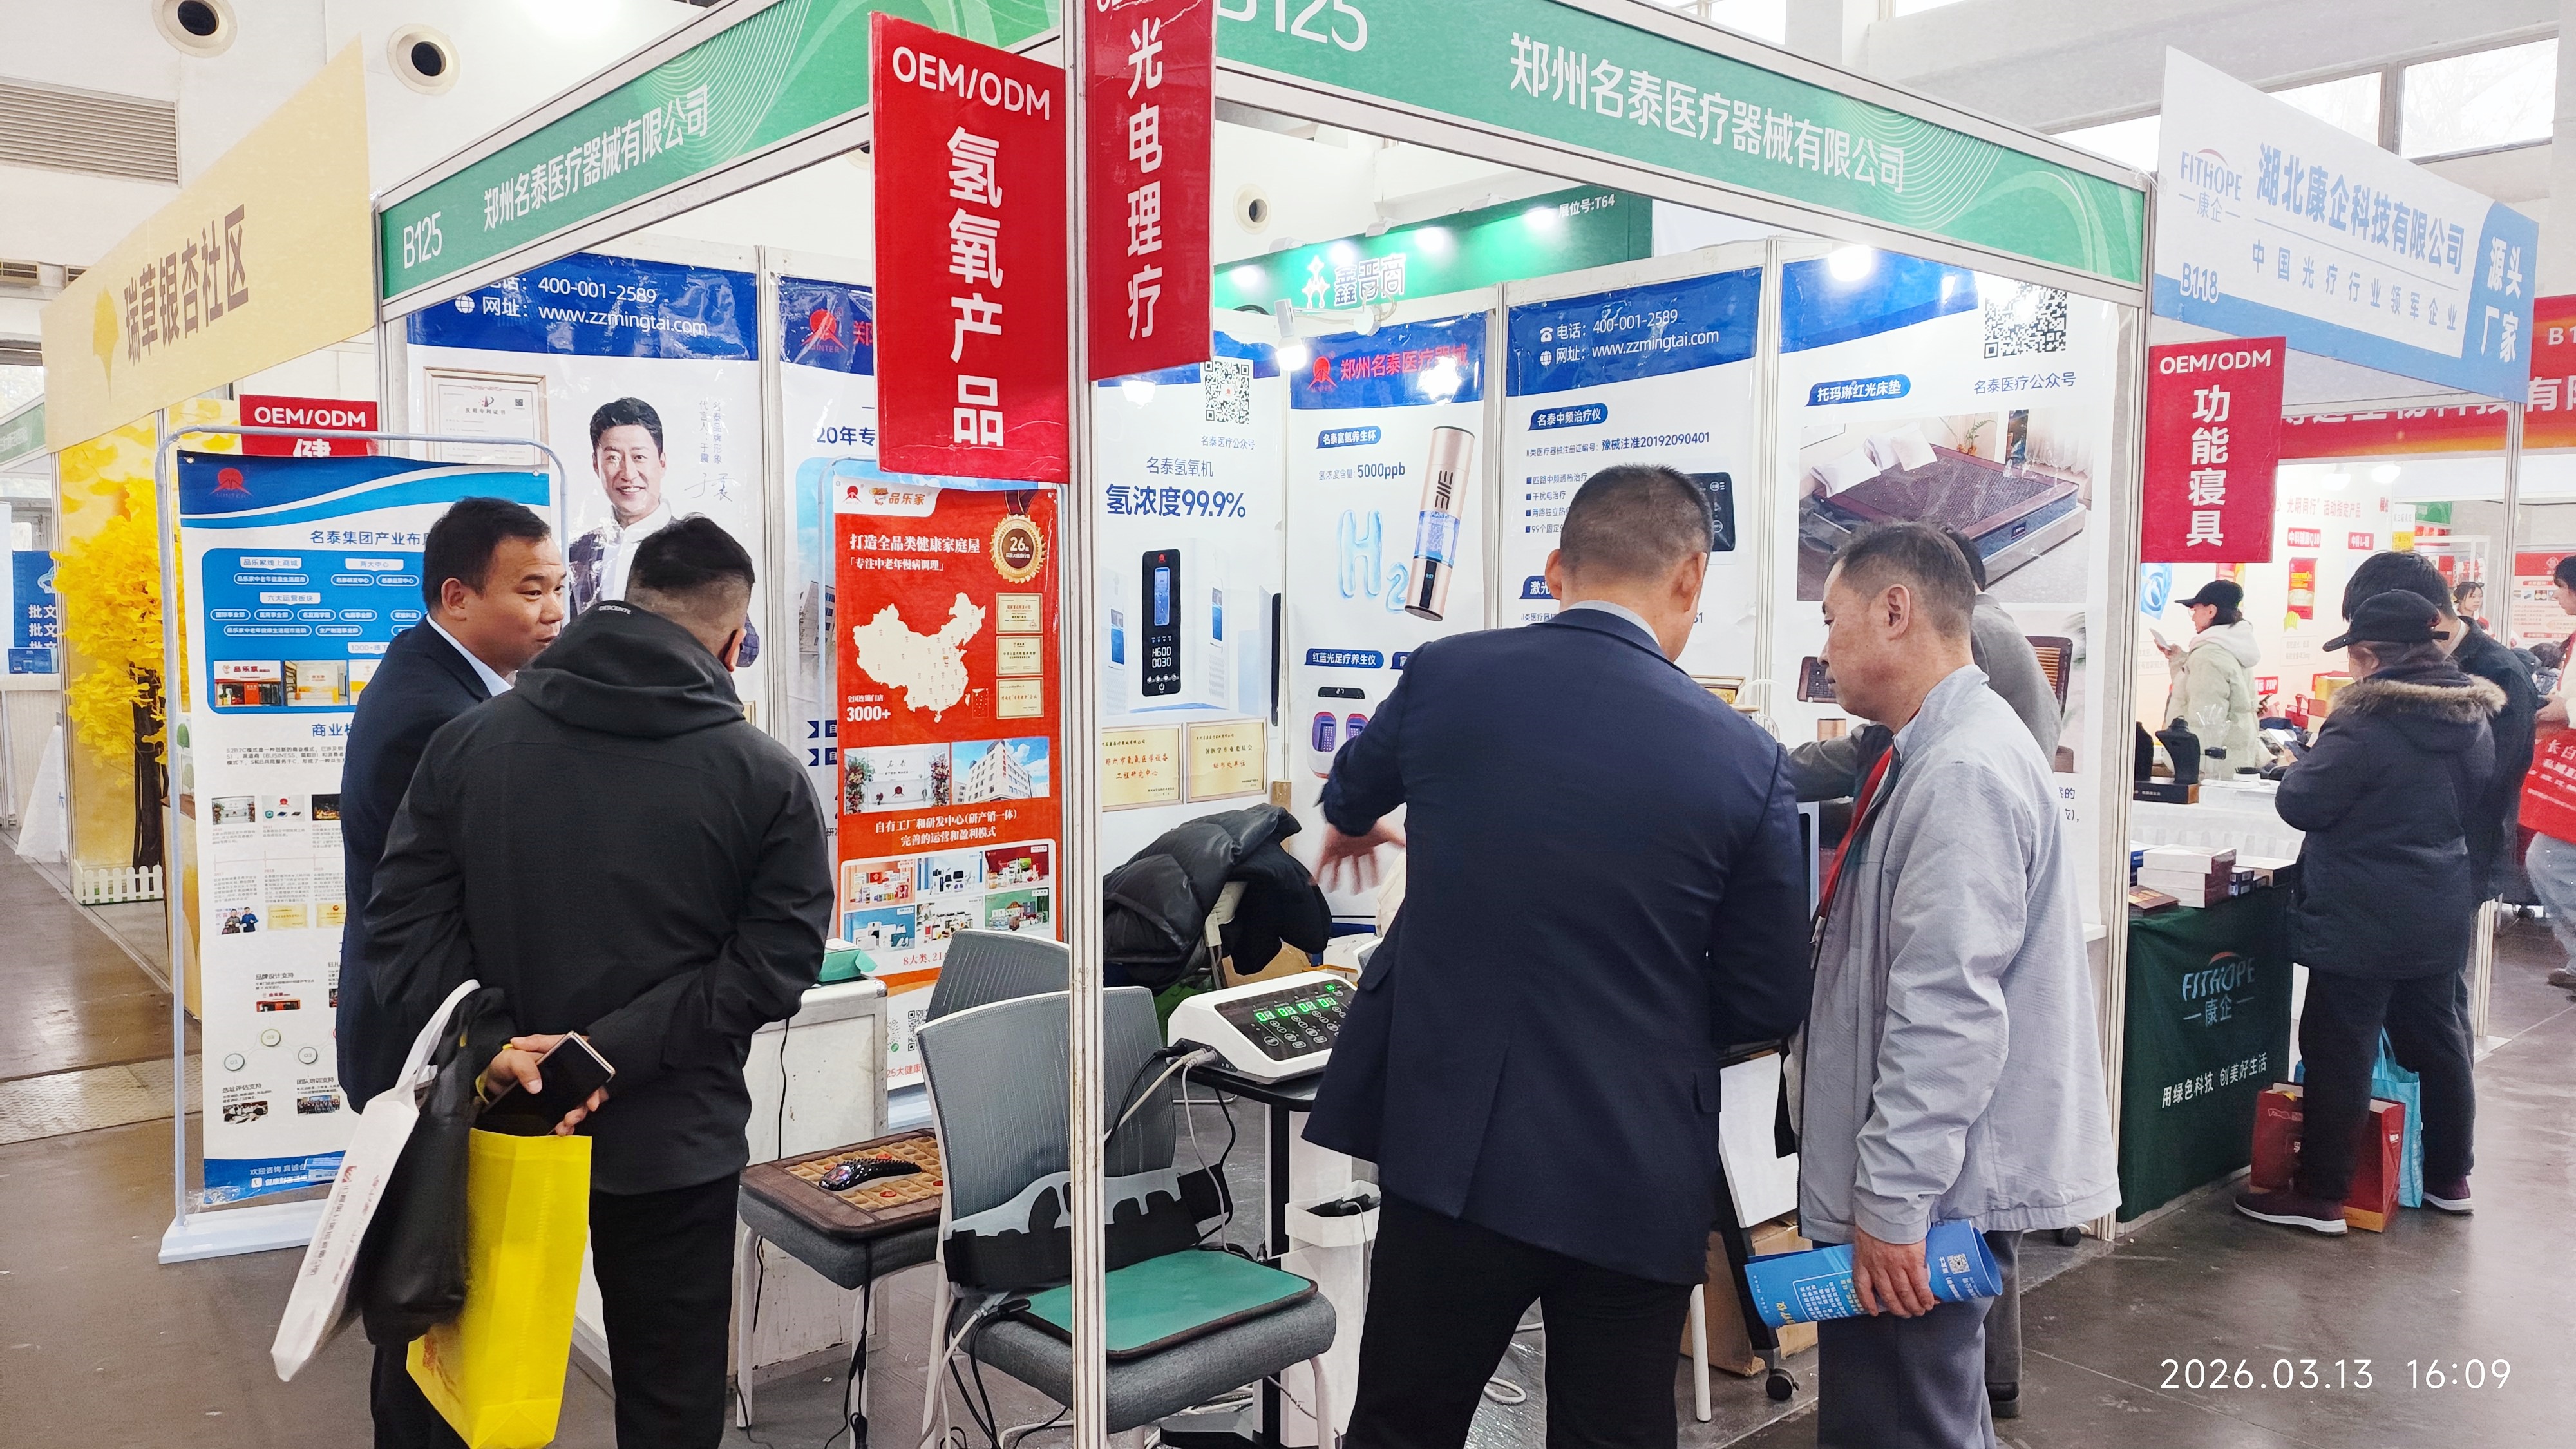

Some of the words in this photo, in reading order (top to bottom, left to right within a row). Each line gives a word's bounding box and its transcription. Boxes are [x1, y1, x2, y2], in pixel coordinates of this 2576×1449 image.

[892, 46, 1051, 121] OEM/ODM
[1510, 32, 1906, 194] 郑州名泰医疗器械有限公司
[484, 84, 708, 232] 郑州名泰医疗器械有限公司
[1126, 17, 1163, 341] 光电理疗
[1557, 194, 1616, 220] 展位号:T64
[2196, 191, 2224, 223] 康企
[2256, 142, 2466, 276] 湖北康企科技有限公司
[402, 211, 443, 269] B125
[2486, 236, 2524, 299] 源头
[124, 204, 250, 368] 瑞草银杏社区
[538, 276, 656, 304] 400-001-2589
[947, 127, 1005, 448] 氢氧产品
[2179, 261, 2220, 304] B118
[2252, 238, 2458, 332] 中国光疗行业领军企业
[538, 305, 708, 336] www.zzmingtai.com
[1593, 309, 1678, 334] 400-001-2589
[2480, 304, 2521, 365] 厂家
[1592, 330, 1719, 358] www.zzmingtai.com
[2159, 348, 2273, 375] OEM/ODM
[1817, 378, 1903, 402] 托玛琳红光床垫
[1973, 371, 2076, 395] 名泰医疗公众号
[254, 406, 366, 428] OEM/ODM
[1537, 407, 1602, 426] 名泰中频治疗仪
[817, 425, 875, 447] 20年专
[1200, 434, 1255, 450] 名泰医疗公众号
[1322, 429, 1377, 446] 名泰富氢养生杯
[1601, 431, 1710, 451] 豫械注准20192090401
[1146, 456, 1214, 478] 名泰氢氧机
[1358, 462, 1406, 481] 5000ppb
[2186, 384, 2231, 548] 功能寝具
[889, 492, 926, 506] 品乐家
[1105, 483, 1246, 519] 氢浓度99.9%
[849, 533, 981, 554] 打造全品类健康家庭屋
[1312, 650, 1377, 666] 红蓝光足疗养生仪
[846, 705, 892, 723] 3000+
[900, 826, 997, 848] 完善的运营和盈利模式
[2204, 994, 2233, 1027] 康企
[2162, 1070, 2214, 1108] 用绿色科技
[2219, 1052, 2268, 1086] 创美好生活
[249, 1166, 282, 1175] 欢迎咨询
